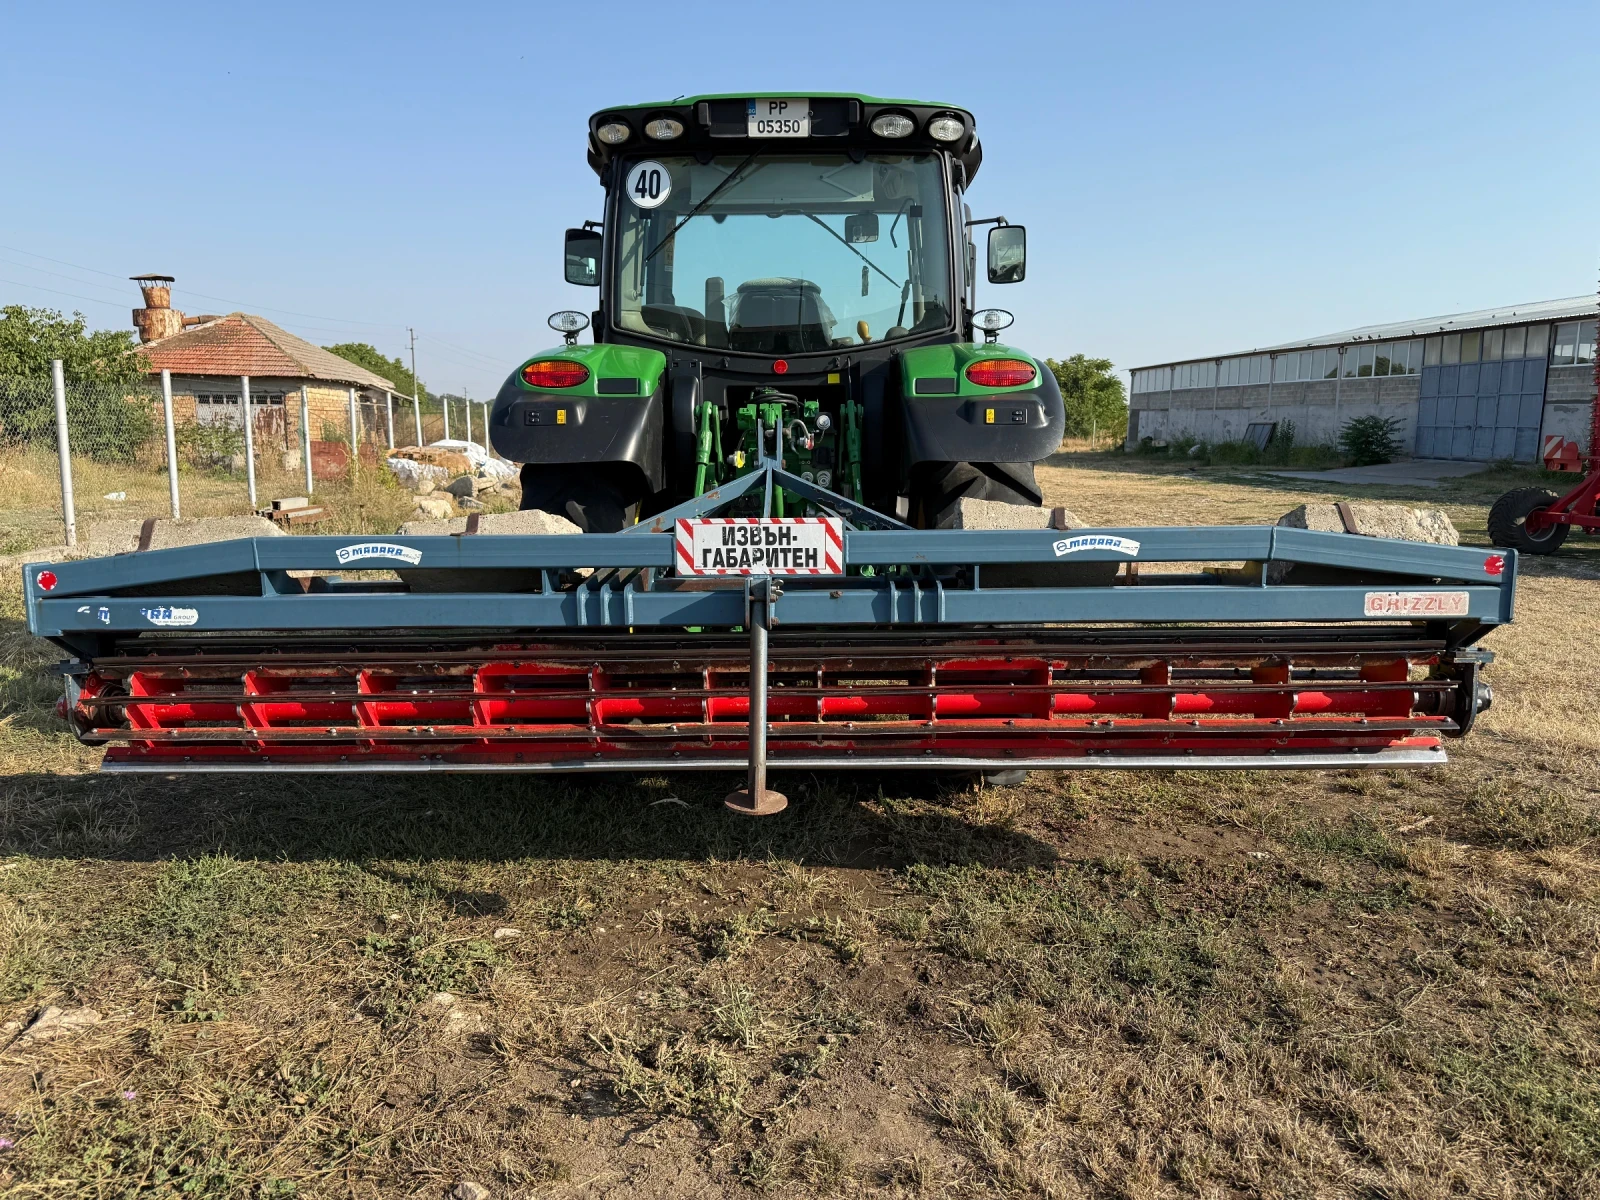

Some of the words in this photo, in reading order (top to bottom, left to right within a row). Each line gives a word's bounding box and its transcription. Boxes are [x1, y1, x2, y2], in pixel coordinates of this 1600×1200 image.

[757, 120, 800, 133] 05350
[635, 169, 661, 199] 40
[721, 526, 798, 546] ИЗВЪН-
[1069, 538, 1122, 548] MADARA
[352, 546, 403, 556] MADARA
[702, 548, 818, 567] ГАБАРИТЕН
[1370, 597, 1462, 611] GRIZZLY
